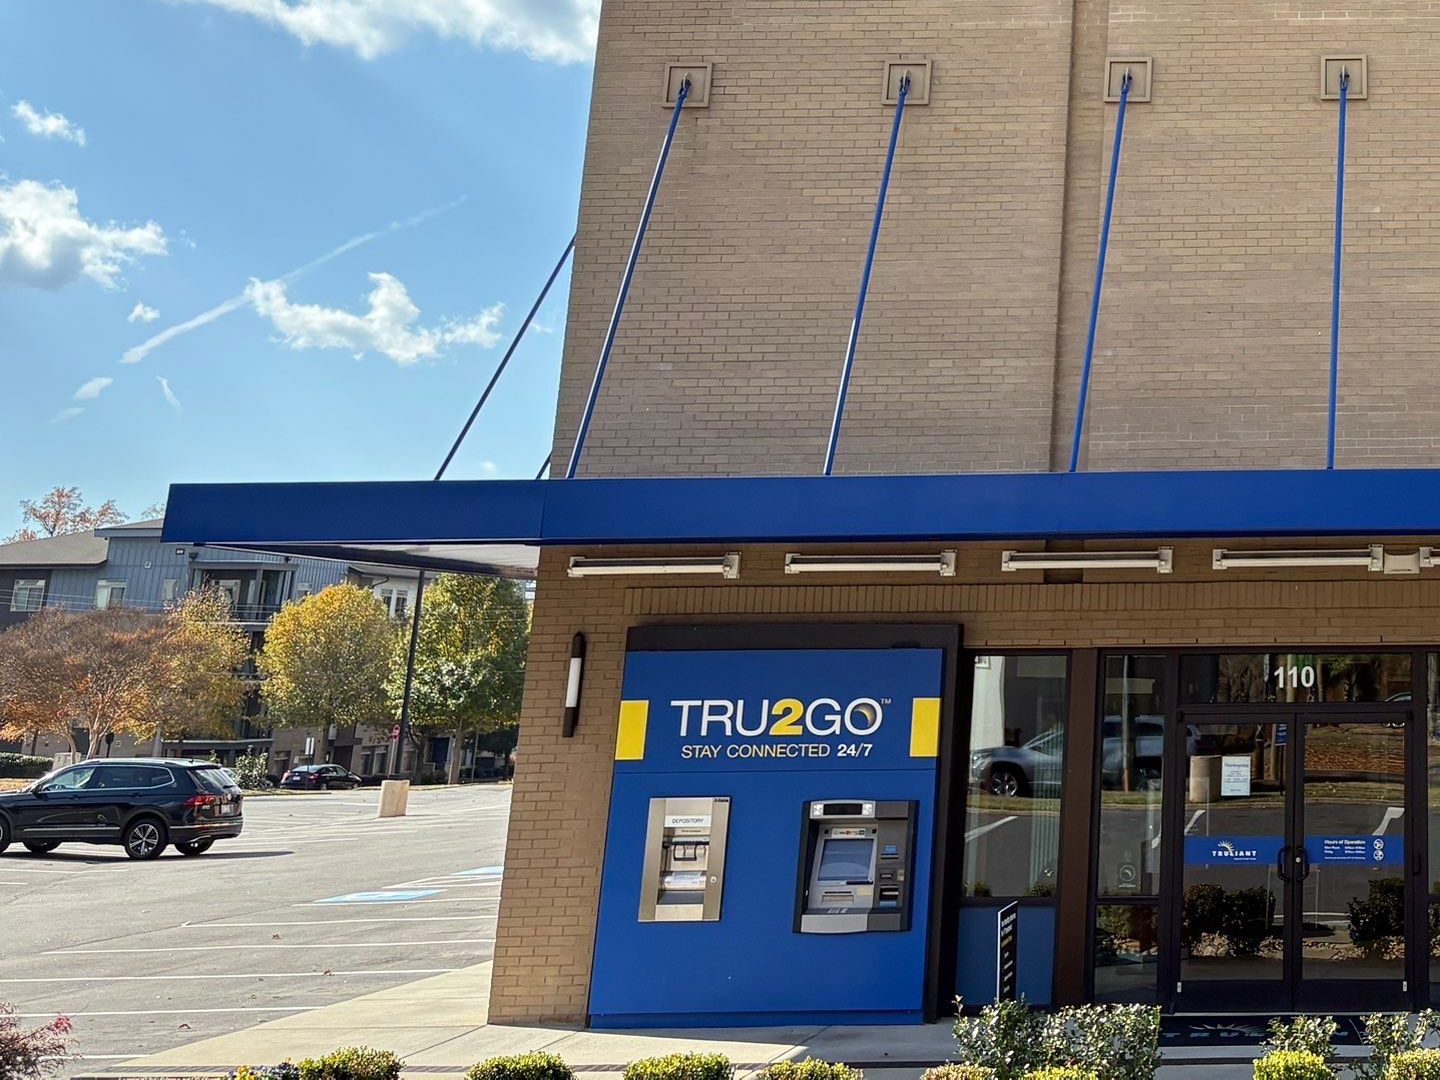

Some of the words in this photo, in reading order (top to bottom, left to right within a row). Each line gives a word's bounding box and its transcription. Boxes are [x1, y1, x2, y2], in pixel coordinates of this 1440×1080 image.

[1273, 666, 1315, 688] 110
[681, 745, 722, 758] STAY
[726, 743, 831, 758] CONNECTED
[836, 743, 873, 757] 24/7
